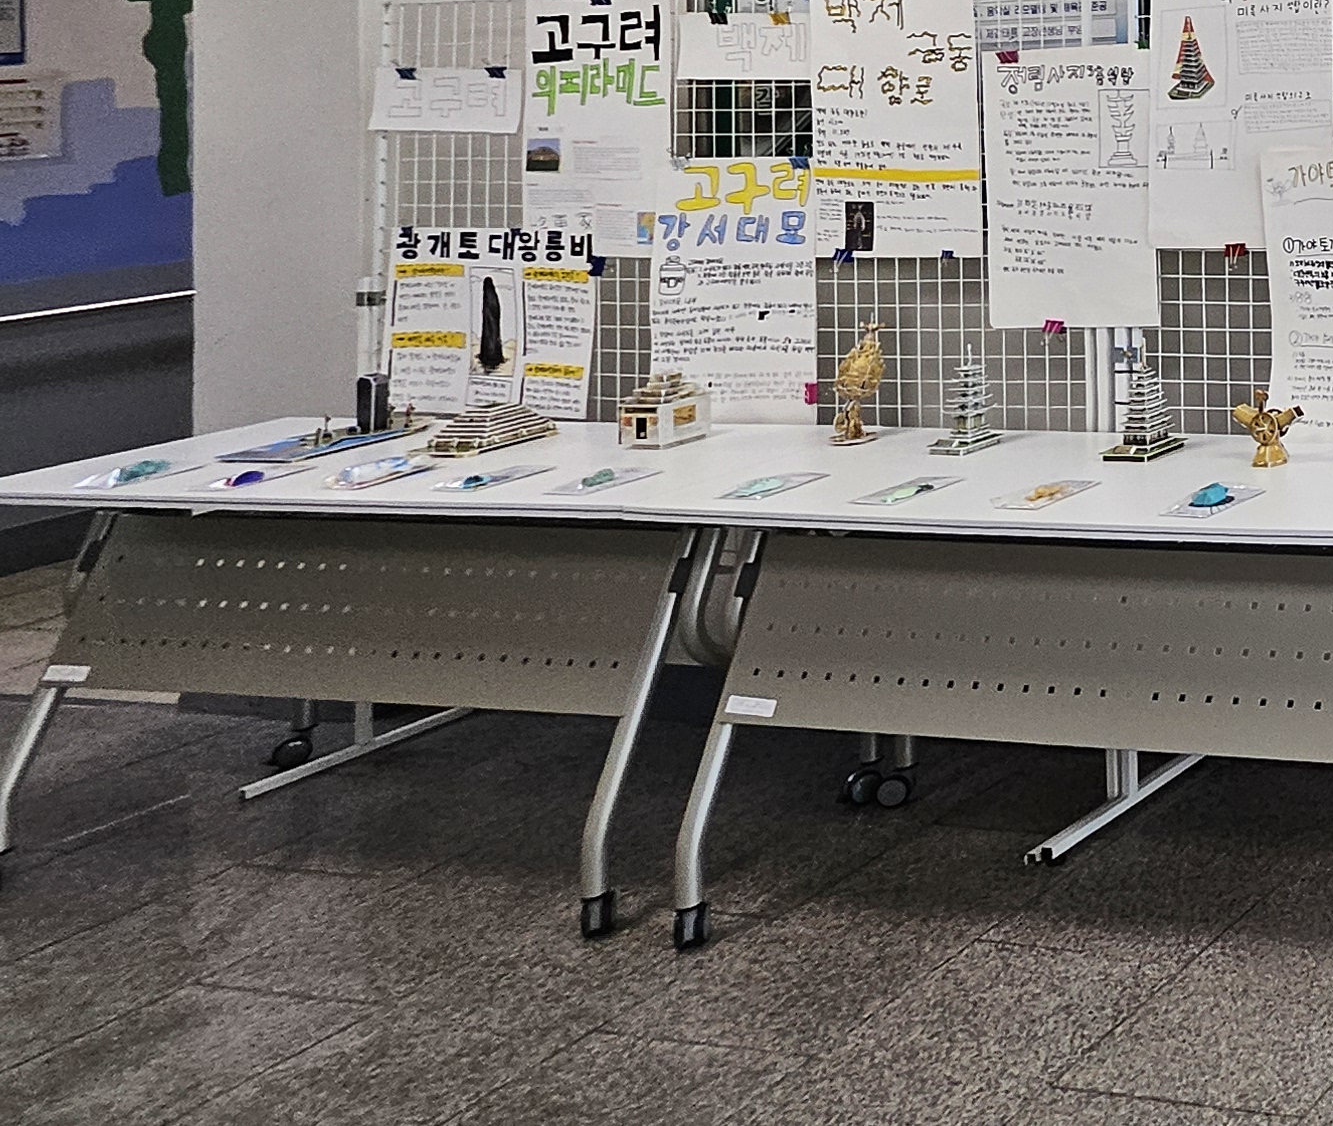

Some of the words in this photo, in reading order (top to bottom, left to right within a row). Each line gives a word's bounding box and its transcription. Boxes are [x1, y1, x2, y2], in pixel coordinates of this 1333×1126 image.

[531, 4, 661, 64] 고구려
[716, 22, 808, 72] 백제
[388, 77, 508, 118] 고구려
[676, 161, 811, 215] 고구려
